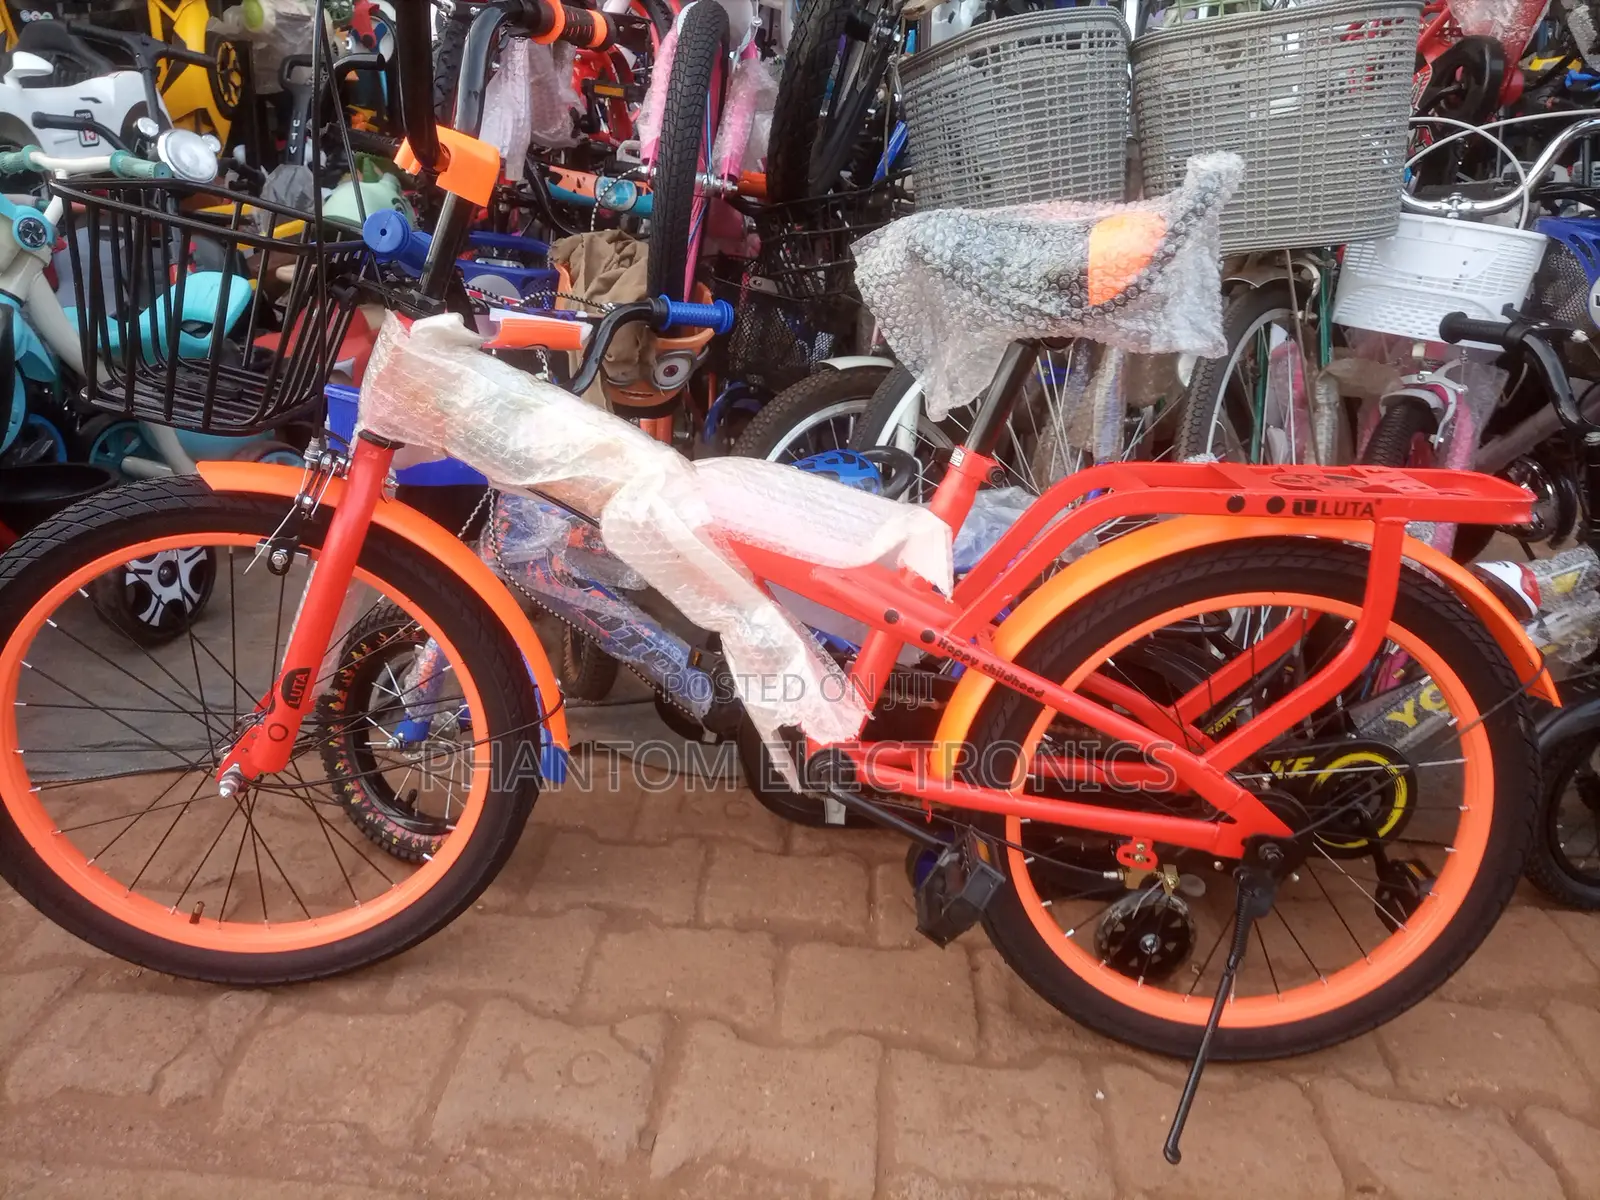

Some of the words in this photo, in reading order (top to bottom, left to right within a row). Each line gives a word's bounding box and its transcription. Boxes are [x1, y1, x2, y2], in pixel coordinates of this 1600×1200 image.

[289, 119, 301, 155] UTV
[1320, 500, 1375, 518] LUTA
[288, 673, 309, 705] LUTA
